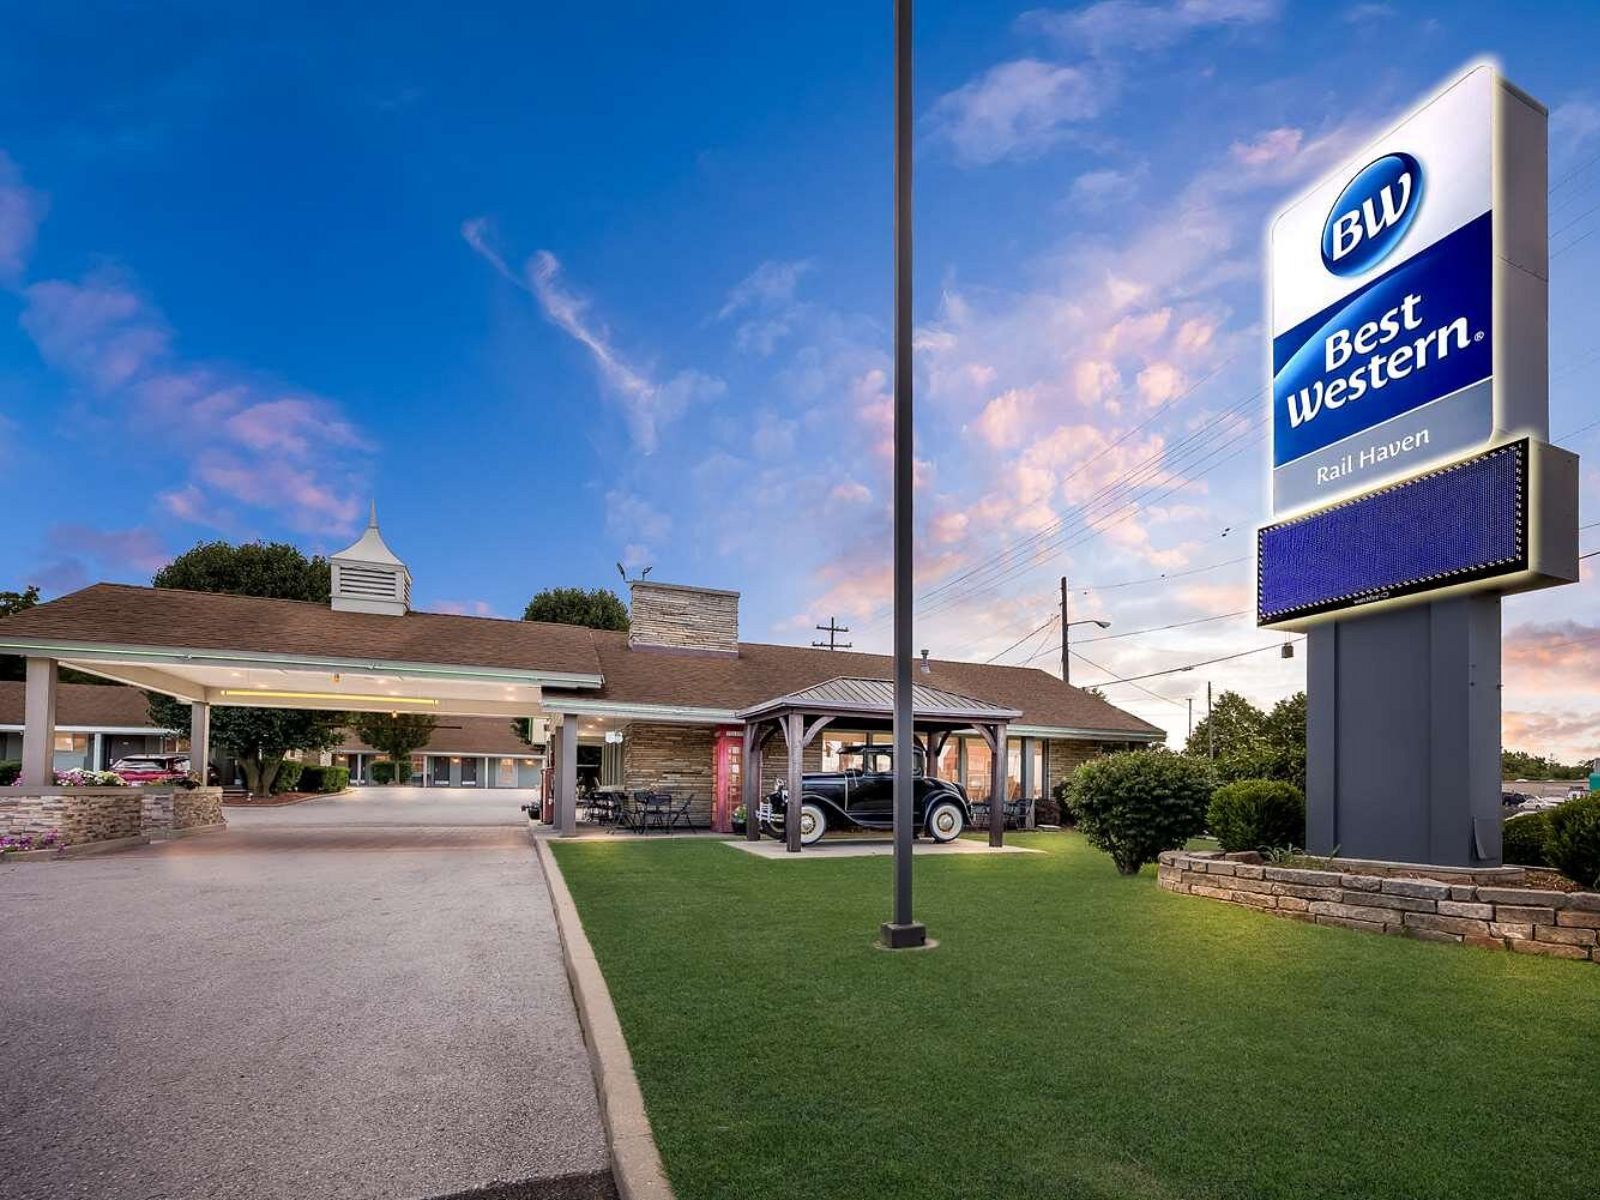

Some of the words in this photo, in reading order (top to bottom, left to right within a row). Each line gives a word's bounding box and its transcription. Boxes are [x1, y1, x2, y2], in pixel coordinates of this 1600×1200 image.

[1332, 172, 1411, 261] BW
[1325, 293, 1423, 373] Best
[1317, 456, 1353, 485] Rail
[1359, 429, 1430, 469] Haven
